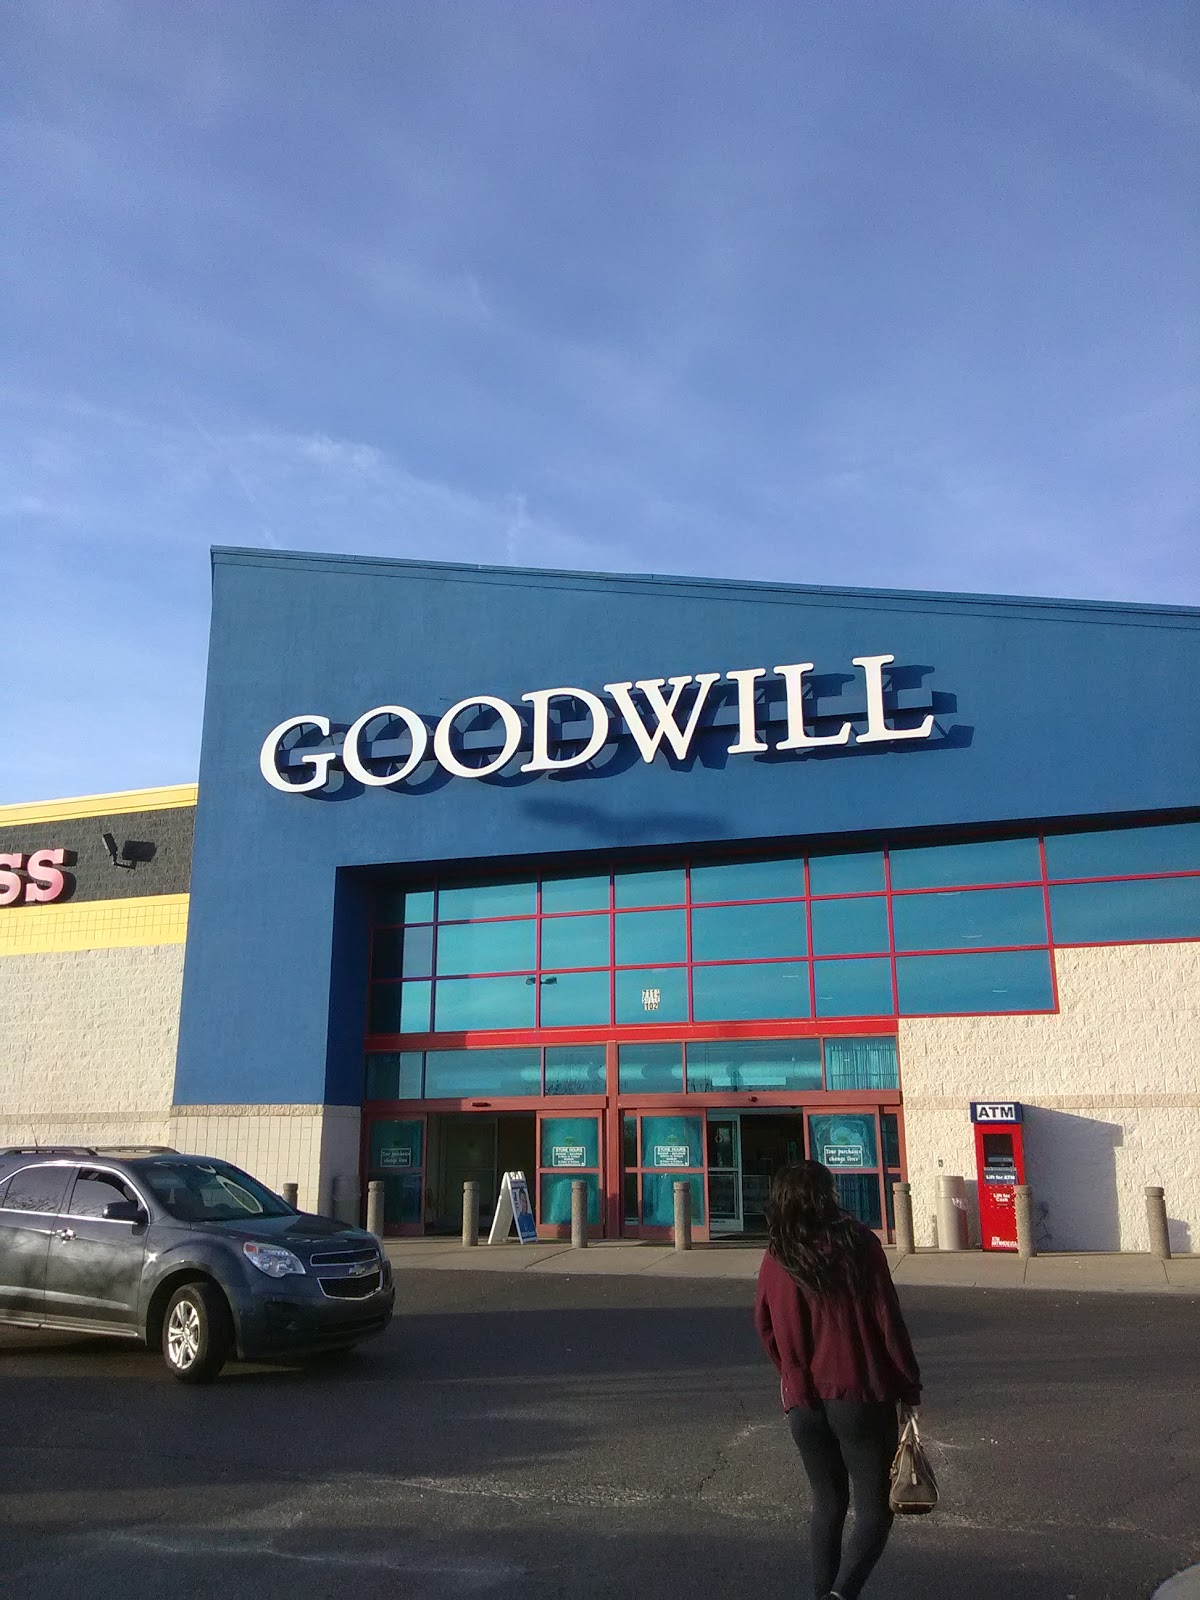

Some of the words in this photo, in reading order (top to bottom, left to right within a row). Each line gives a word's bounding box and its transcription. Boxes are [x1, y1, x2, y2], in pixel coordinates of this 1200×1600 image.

[259, 654, 934, 794] GOODWILL
[645, 1002, 658, 1010] 102
[978, 1106, 1015, 1118] ATM
